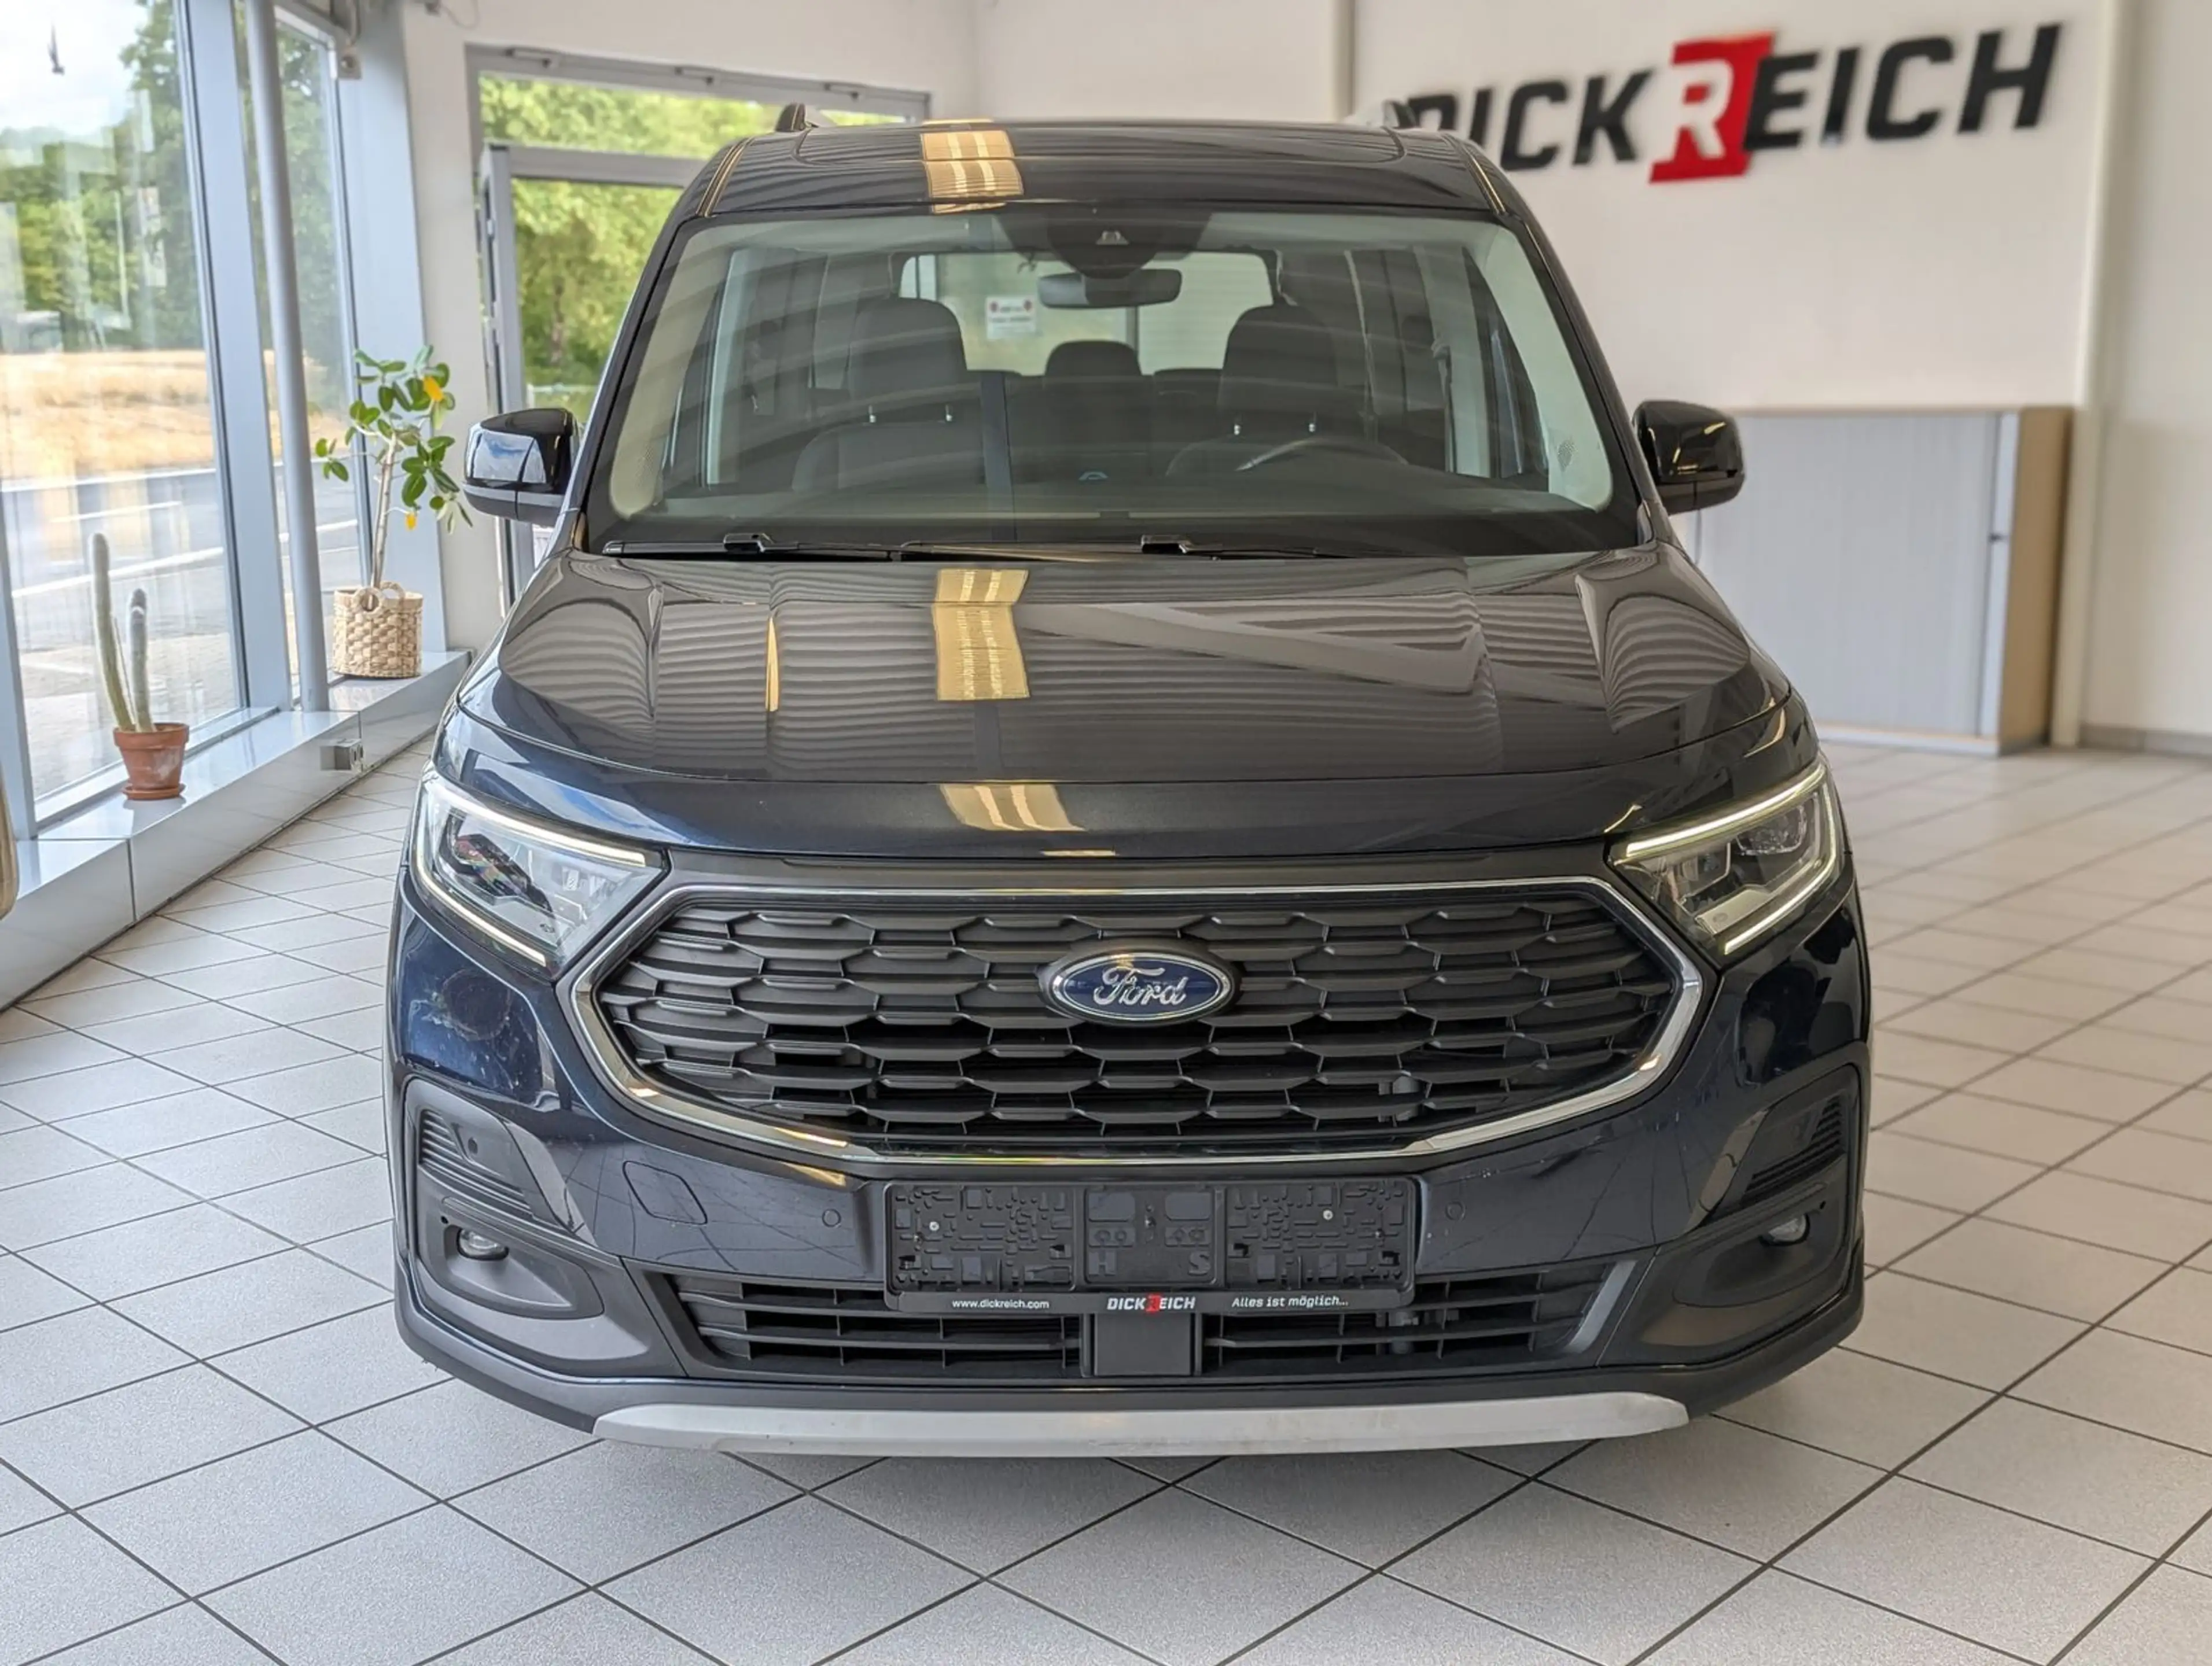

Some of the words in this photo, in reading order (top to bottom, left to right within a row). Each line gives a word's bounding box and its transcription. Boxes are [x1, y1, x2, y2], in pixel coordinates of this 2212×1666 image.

[1093, 966, 1189, 1006] Ford
[952, 1298, 1050, 1310] www.dickreich.com
[1232, 1296, 1264, 1307] Alles
[1266, 1296, 1285, 1307] ist
